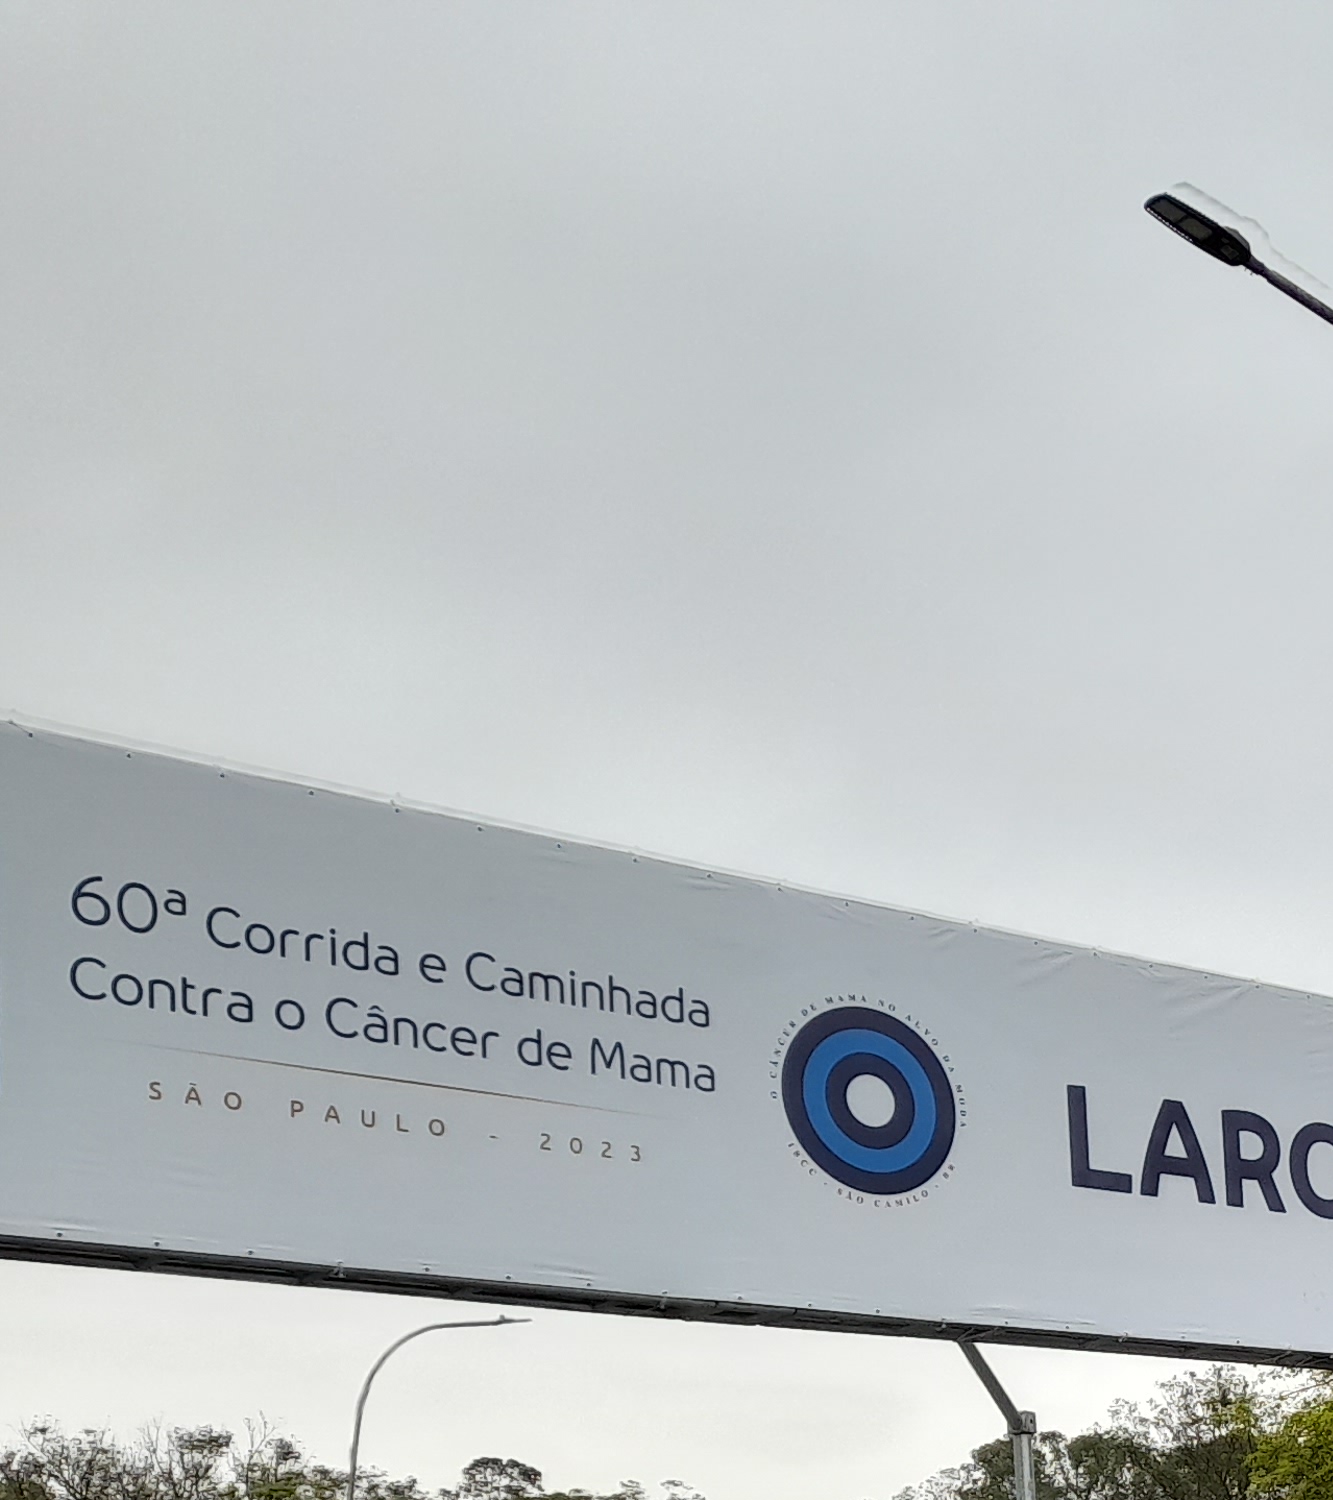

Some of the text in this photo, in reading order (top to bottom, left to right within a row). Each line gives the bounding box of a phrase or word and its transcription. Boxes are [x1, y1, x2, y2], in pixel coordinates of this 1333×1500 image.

[206, 906, 399, 976] Corrida
[418, 952, 447, 983] e
[465, 951, 711, 1028] Caminhada
[70, 956, 716, 1092] Contra o Câncer de Mama
[825, 993, 867, 1004] MAMA
[878, 999, 896, 1012] NO
[905, 1014, 939, 1047] ALVO
[148, 1081, 243, 1112] SÃO
[290, 1100, 446, 1137] PAULO
[540, 1132, 642, 1163] 2023
